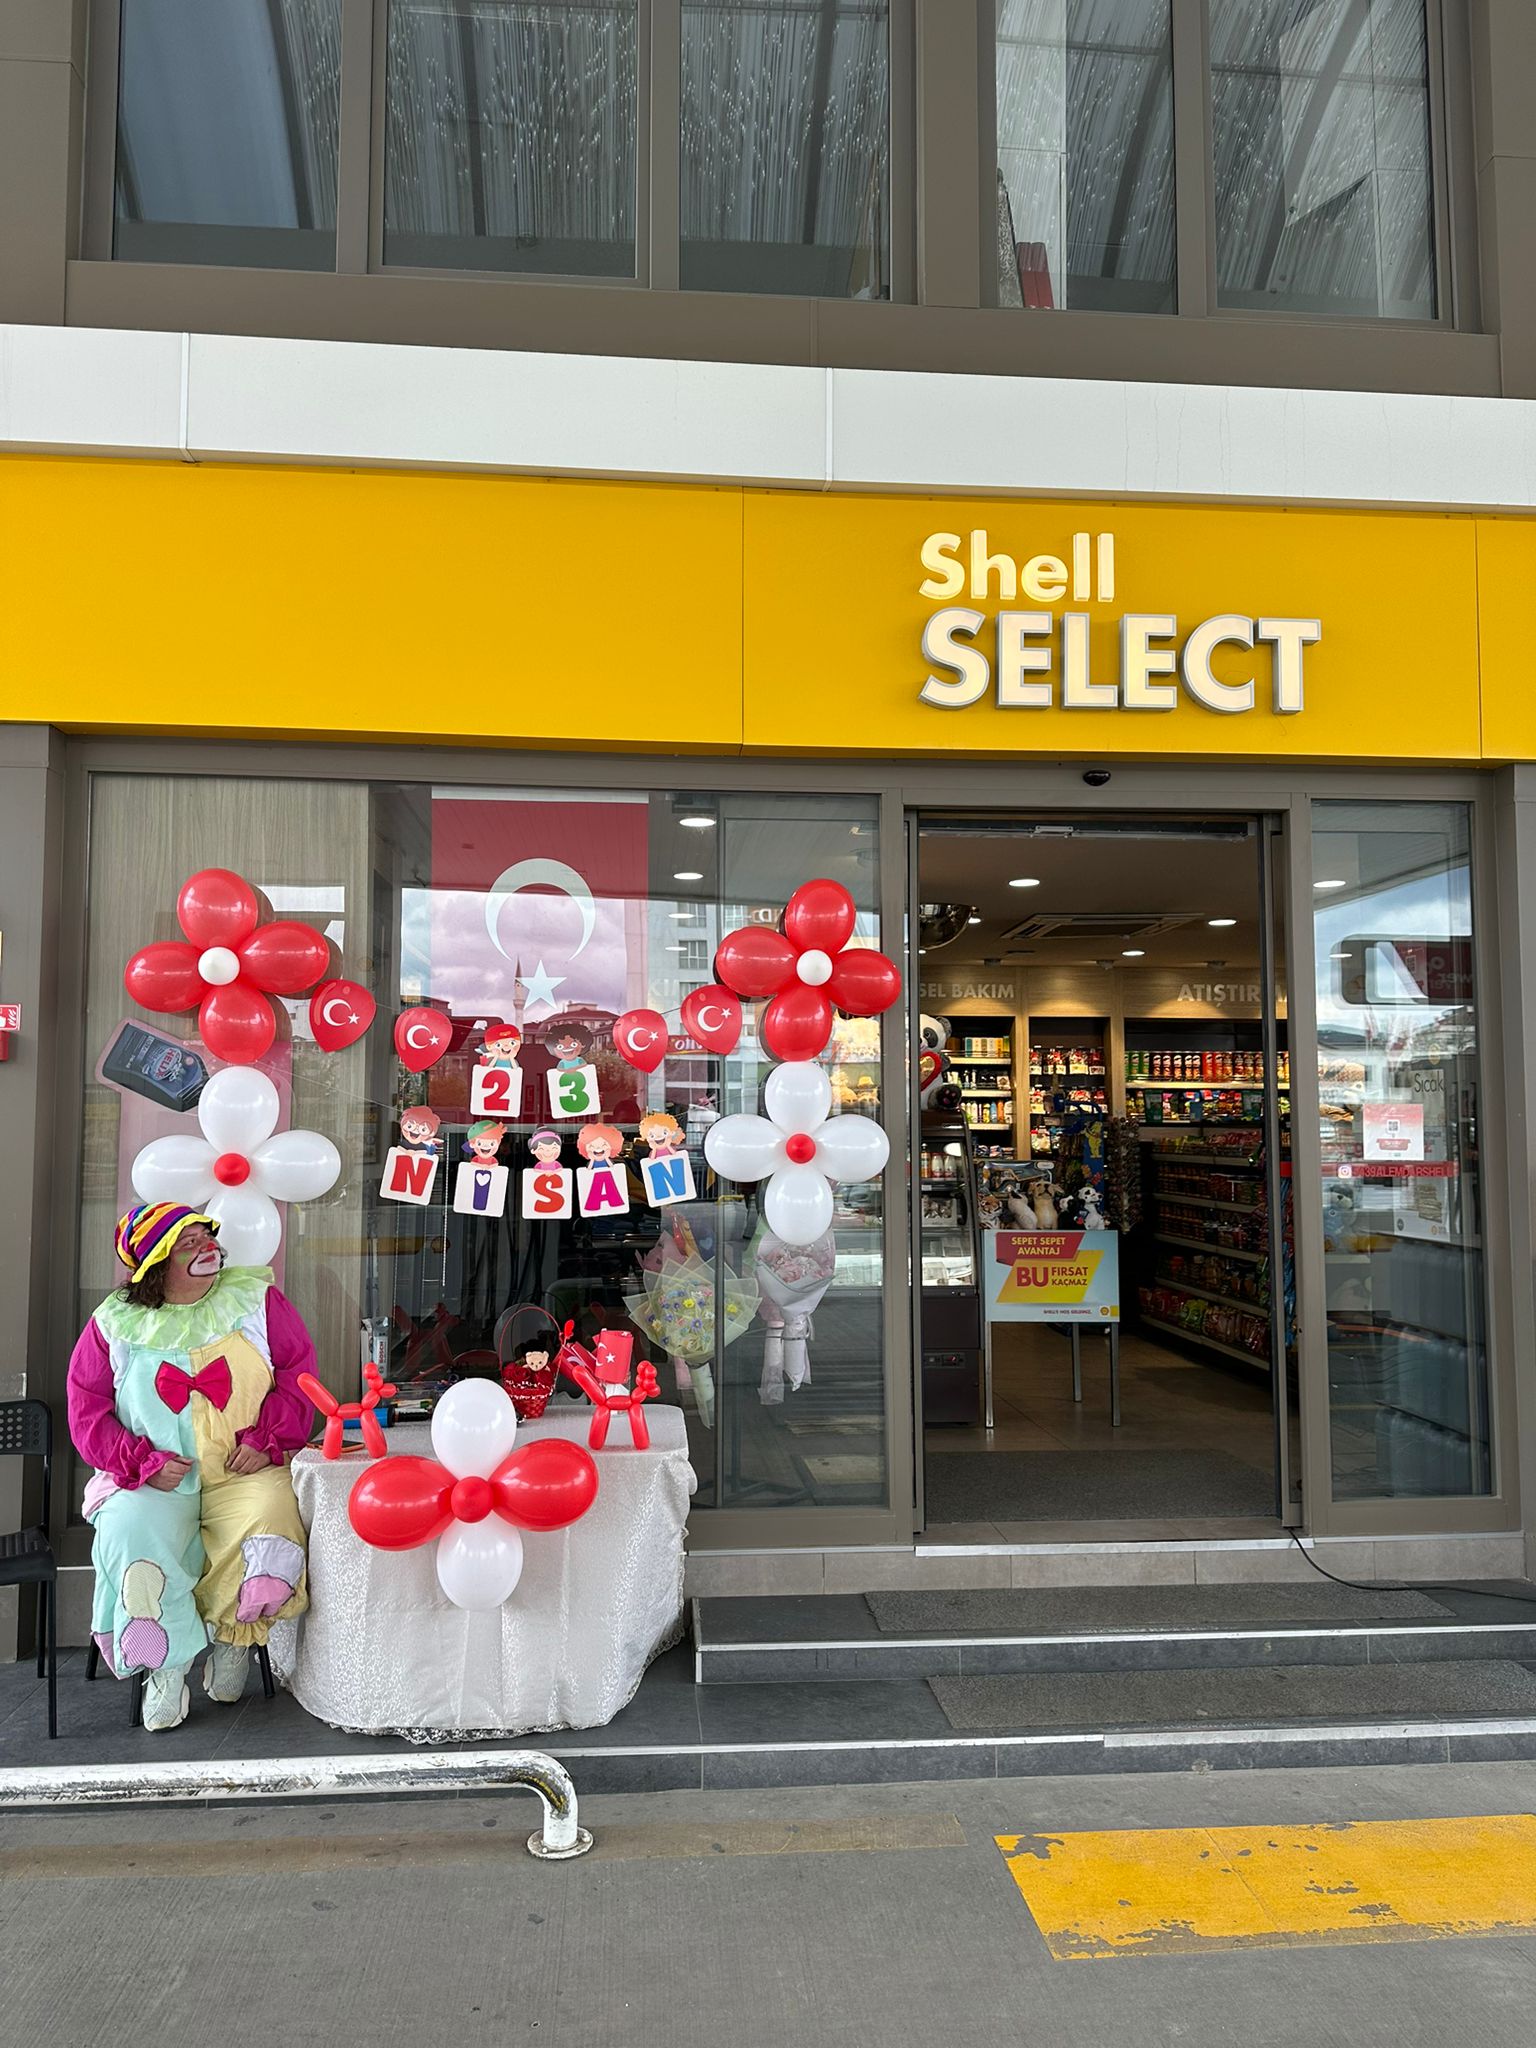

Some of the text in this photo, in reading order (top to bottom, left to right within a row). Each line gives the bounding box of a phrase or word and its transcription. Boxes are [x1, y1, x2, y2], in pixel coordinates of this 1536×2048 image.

[918, 529, 1115, 603] Shell
[918, 606, 1322, 716] SELECT
[951, 983, 1015, 999] BAKIM
[481, 1069, 590, 1113] 23
[1011, 1236, 1066, 1246] SEPET SEPET
[1017, 1247, 1061, 1256] AVANTAJ
[1016, 1266, 1049, 1287] BU
[1051, 1266, 1089, 1276] FIRSAT
[1051, 1278, 1088, 1287] KAÇMAZ
